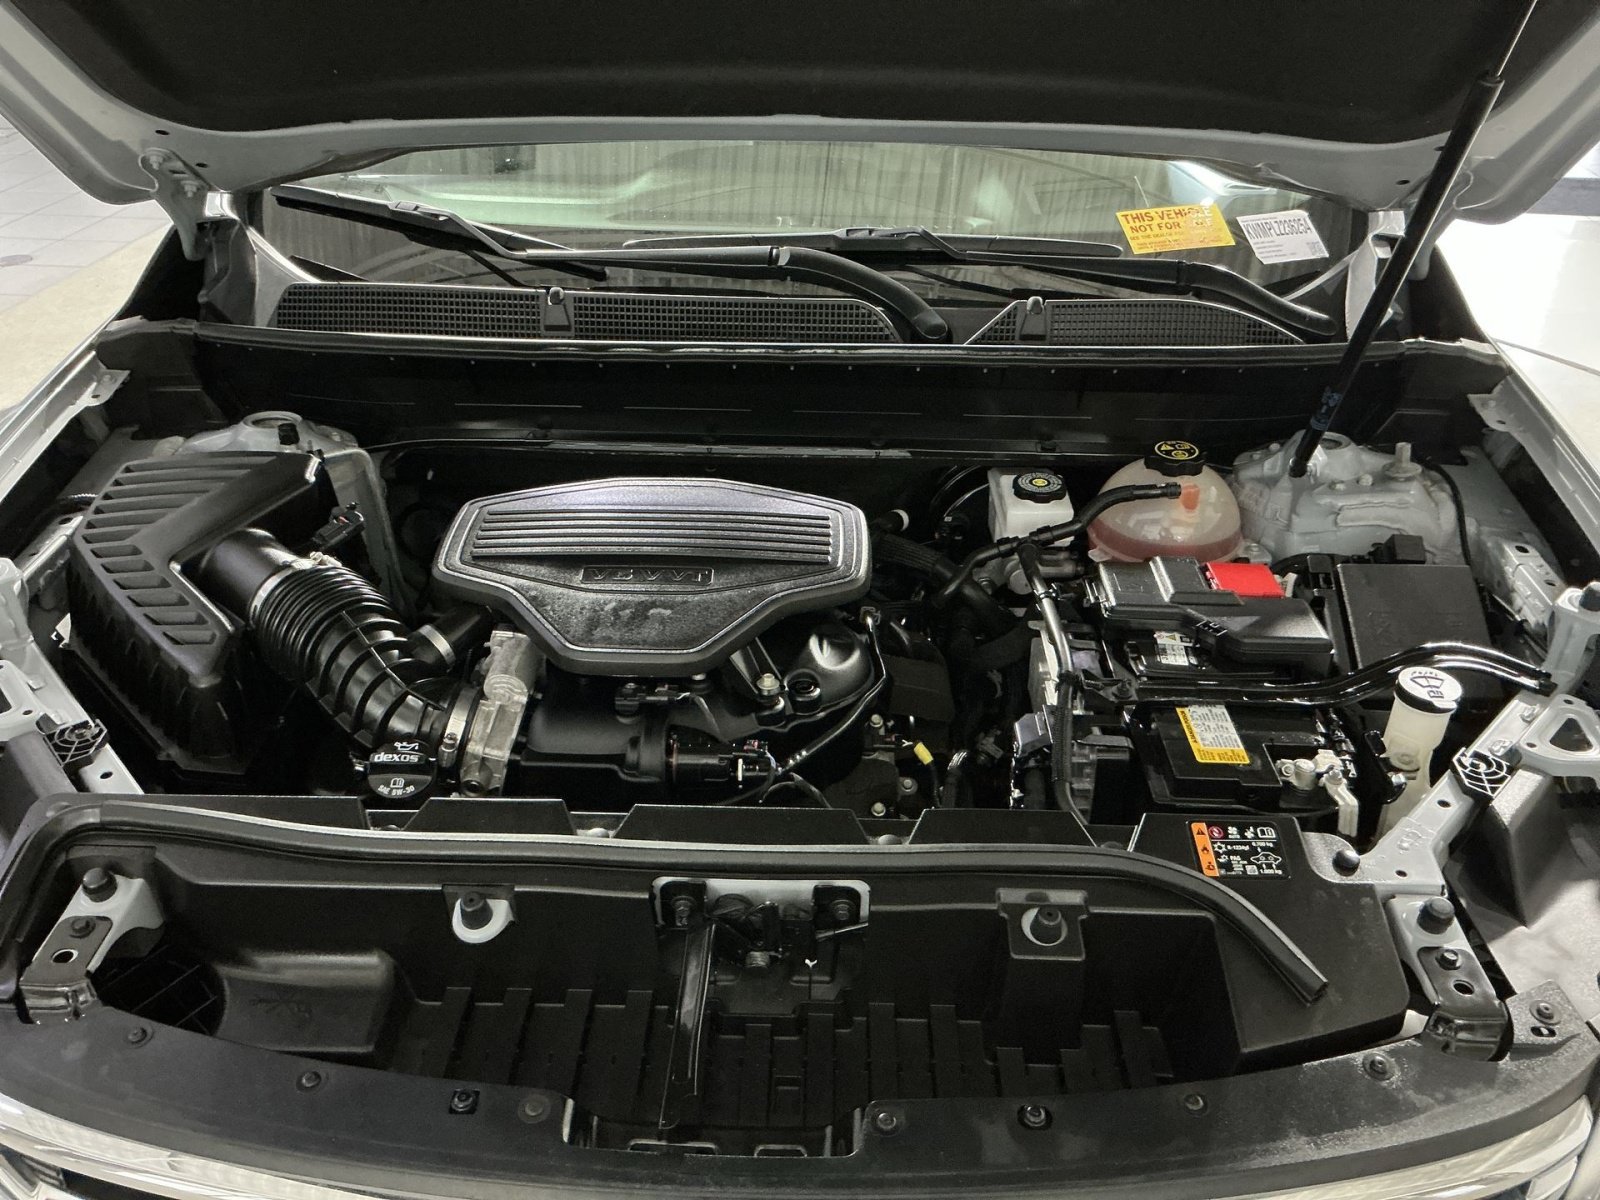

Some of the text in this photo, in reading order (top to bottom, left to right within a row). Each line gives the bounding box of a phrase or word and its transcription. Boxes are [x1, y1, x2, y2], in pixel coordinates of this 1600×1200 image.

[1121, 211, 1154, 224] THIS
[1130, 224, 1154, 233] NOT
[1157, 221, 1182, 231] FOR
[374, 752, 419, 763] dexos
[378, 785, 415, 796] SAE 5W-30
